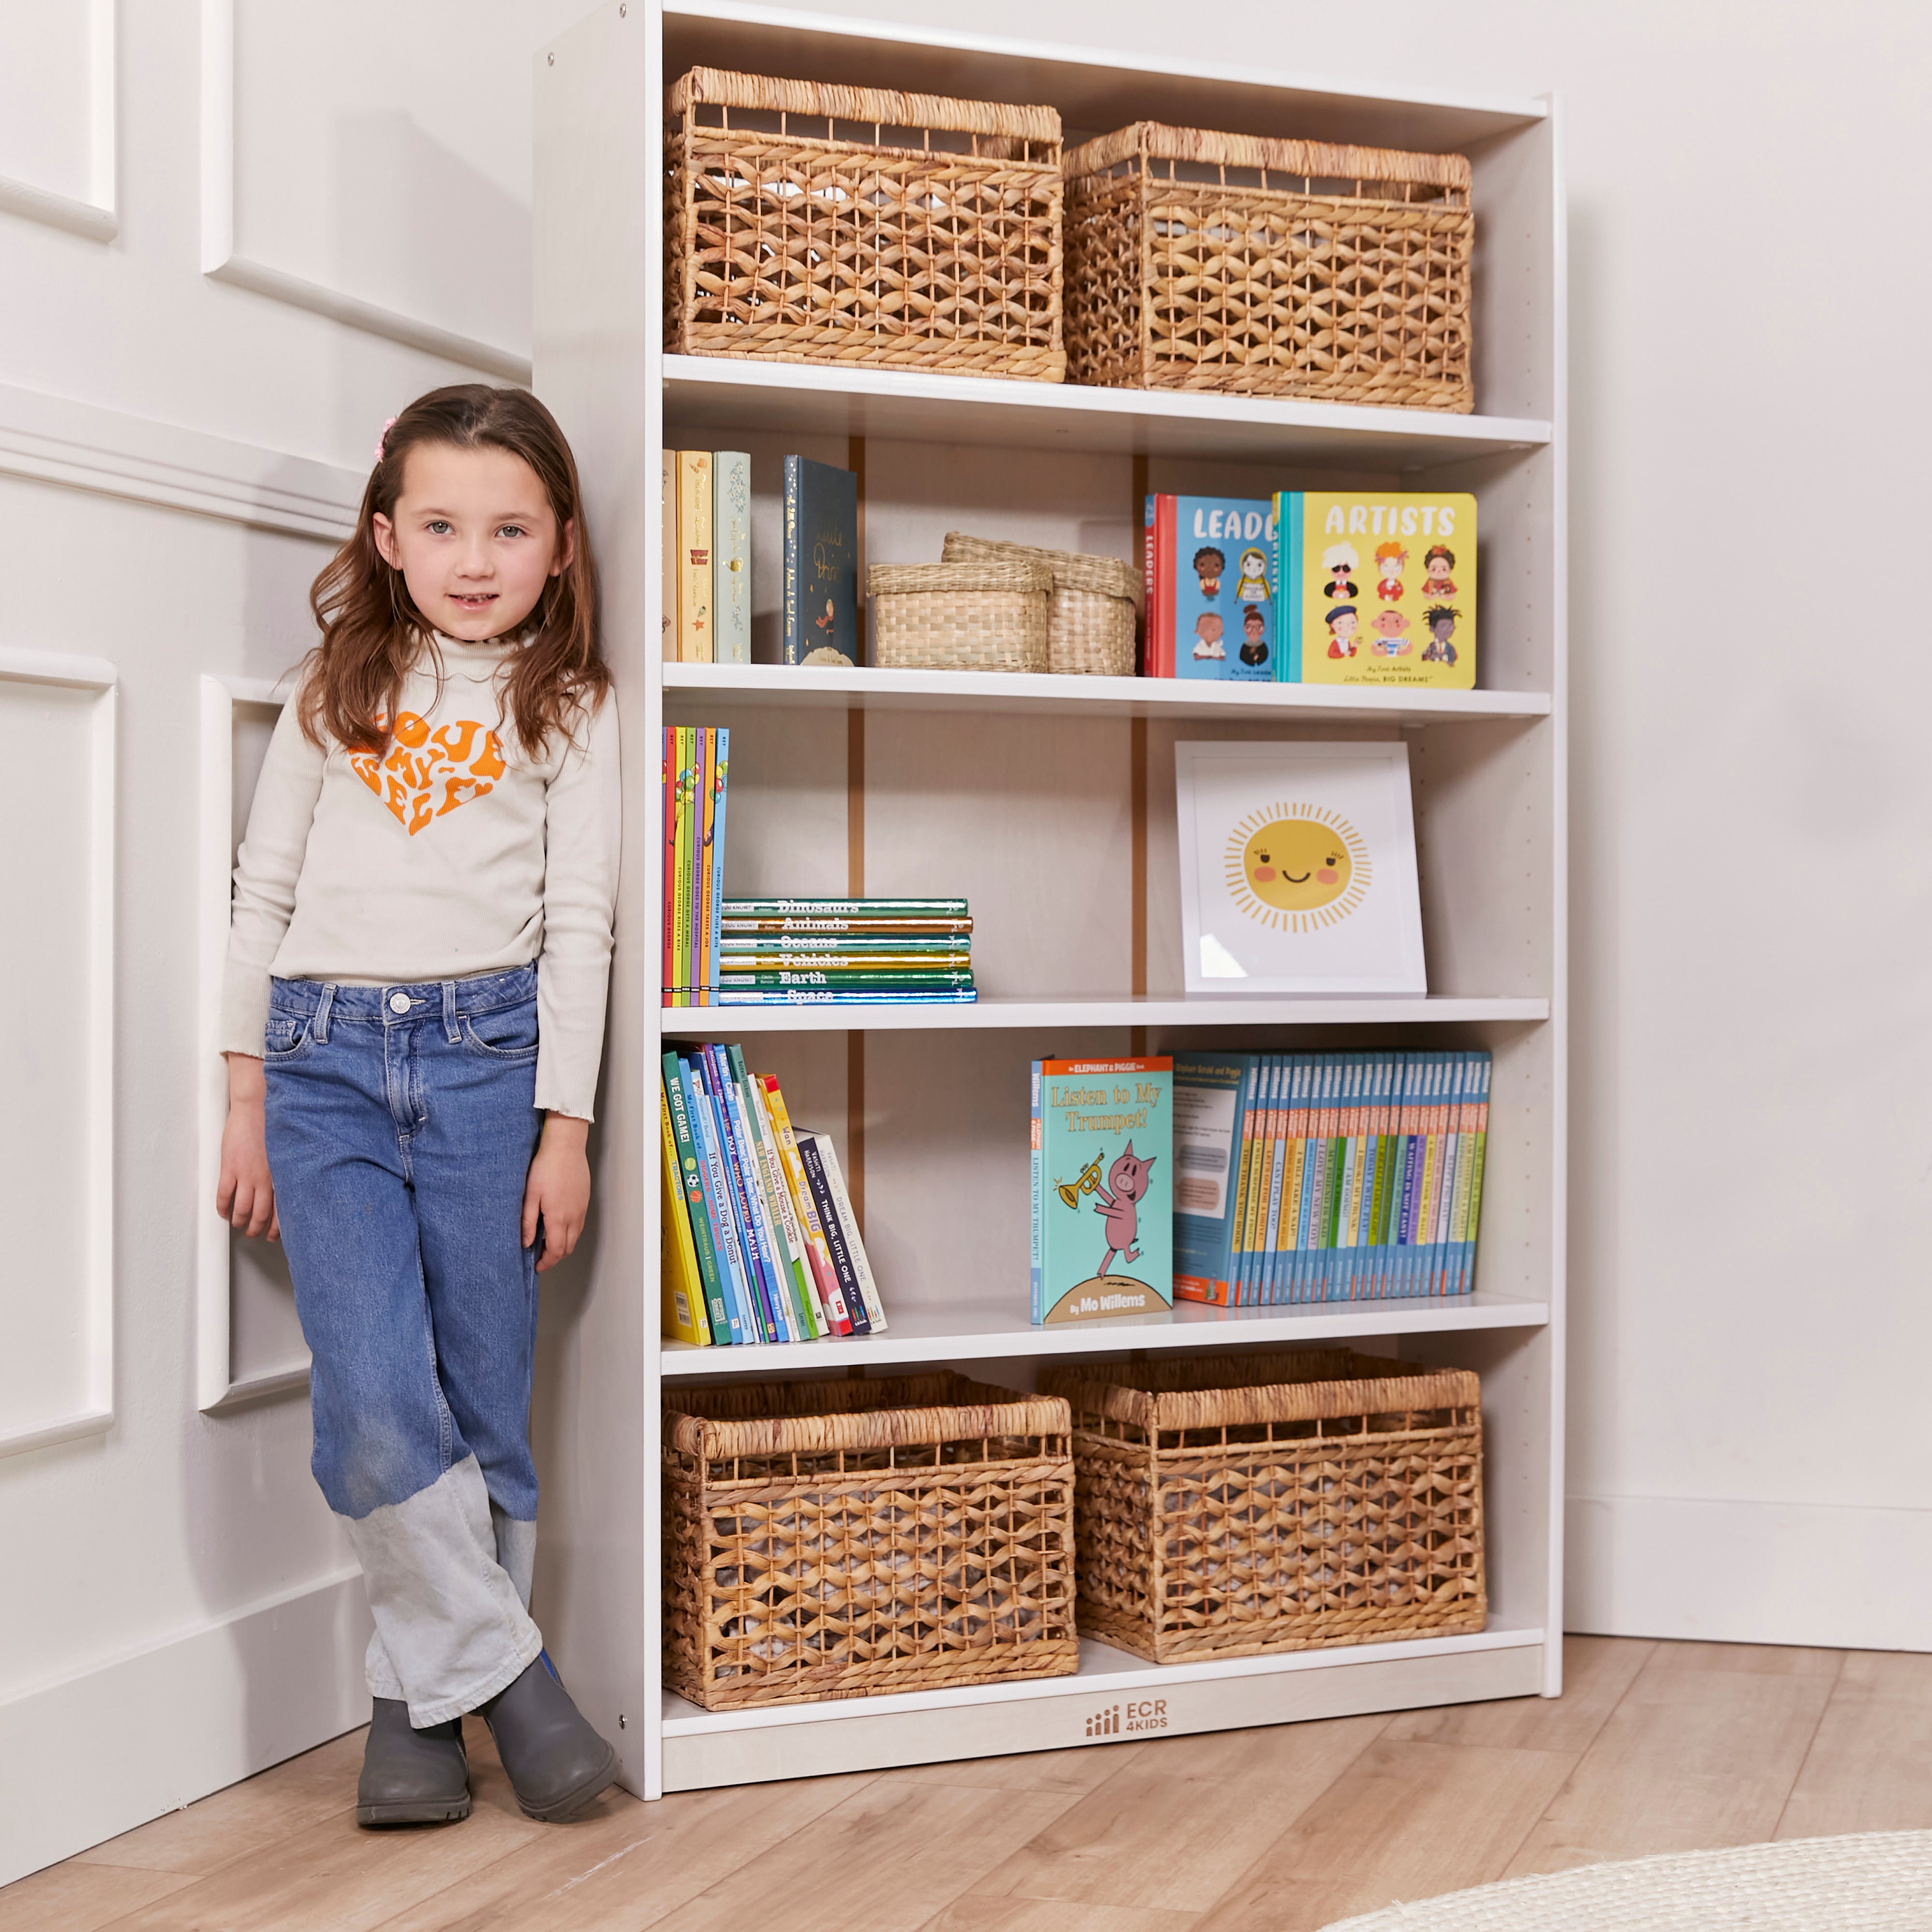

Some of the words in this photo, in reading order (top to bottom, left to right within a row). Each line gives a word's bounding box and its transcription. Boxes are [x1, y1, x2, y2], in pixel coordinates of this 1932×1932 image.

[1325, 505, 1455, 536] ARTISTS
[1145, 535, 1154, 594] LEADERS
[777, 899, 859, 913] Dinosaurs
[781, 917, 849, 930] Animals
[781, 936, 838, 949] Oceans
[779, 953, 849, 966] Vehicles
[779, 971, 827, 984] Earth
[787, 989, 834, 1005] Space
[718, 1052, 730, 1077] Martin
[724, 1081, 735, 1101] Carle
[1074, 1064, 1108, 1073] ELEPHANT
[1115, 1063, 1136, 1071] PIGGIE
[669, 1077, 680, 1092] WE
[1031, 1073, 1040, 1107] Willems
[1249, 1067, 1258, 1099] Willems
[1260, 1066, 1269, 1098] Willems
[672, 1093, 683, 1112] GOT
[686, 1094, 693, 1104] My
[1051, 1087, 1107, 1107] Listen
[1113, 1085, 1130, 1104] to
[1136, 1082, 1162, 1108] My
[676, 1113, 689, 1143] GAME!
[733, 1119, 743, 1138] Polar
[1065, 1108, 1147, 1135] Trumpet!
[781, 1126, 793, 1145] Wan
[708, 1050, 719, 1077] Heiligman
[717, 1088, 725, 1103] Pham
[732, 1161, 743, 1187] WHO
[738, 1191, 752, 1222] LOVED
[745, 1227, 761, 1260] MATH
[737, 1139, 747, 1157] Bear,
[754, 1141, 764, 1156] NEW
[710, 1161, 720, 1178] You
[741, 1158, 752, 1176] Polar
[768, 1155, 776, 1168] You
[803, 1150, 817, 1178] HARRISON
[810, 1151, 822, 1172] VASHTI
[818, 1150, 832, 1177] HARRISON
[826, 1152, 836, 1171] VASHTI
[670, 1160, 684, 1200] TRACTORS
[758, 1159, 774, 1193] ENGLAND
[771, 1169, 780, 1185] Give
[714, 1180, 724, 1199] Give
[745, 1177, 755, 1195] Bear,
[797, 1180, 814, 1209] Dream
[1033, 1190, 1038, 1200] TO
[699, 1160, 710, 1192] DIGGERS
[707, 1200, 716, 1220] DUMP
[712, 1222, 723, 1250] TRUCKS
[749, 1195, 760, 1215] What
[767, 1194, 782, 1225] WHALER
[777, 1192, 787, 1213] Mouse
[820, 1199, 833, 1222] THINK
[835, 1197, 849, 1222] DREAM
[1033, 1203, 1038, 1214] MY
[718, 1209, 730, 1228] Dog
[753, 1215, 762, 1226] Do
[805, 1209, 822, 1232] BIG
[698, 1217, 709, 1255] WEINTRAUB
[756, 1226, 766, 1241] You
[784, 1220, 795, 1243] Cookie
[826, 1223, 838, 1240] BIG,
[843, 1223, 854, 1238] BIG,
[725, 1237, 737, 1264] Donut
[759, 1241, 770, 1263] Hear?
[832, 1240, 846, 1264] LITTLE
[848, 1240, 861, 1263] LITTLE
[840, 1264, 852, 1283] ONE
[856, 1265, 867, 1281] ONE
[1070, 1305, 1079, 1316] By
[1080, 1297, 1098, 1312] Mo
[1100, 1293, 1145, 1310] Willems
[1127, 1699, 1167, 1719] ECR
[1126, 1717, 1168, 1731] 4KIDS
